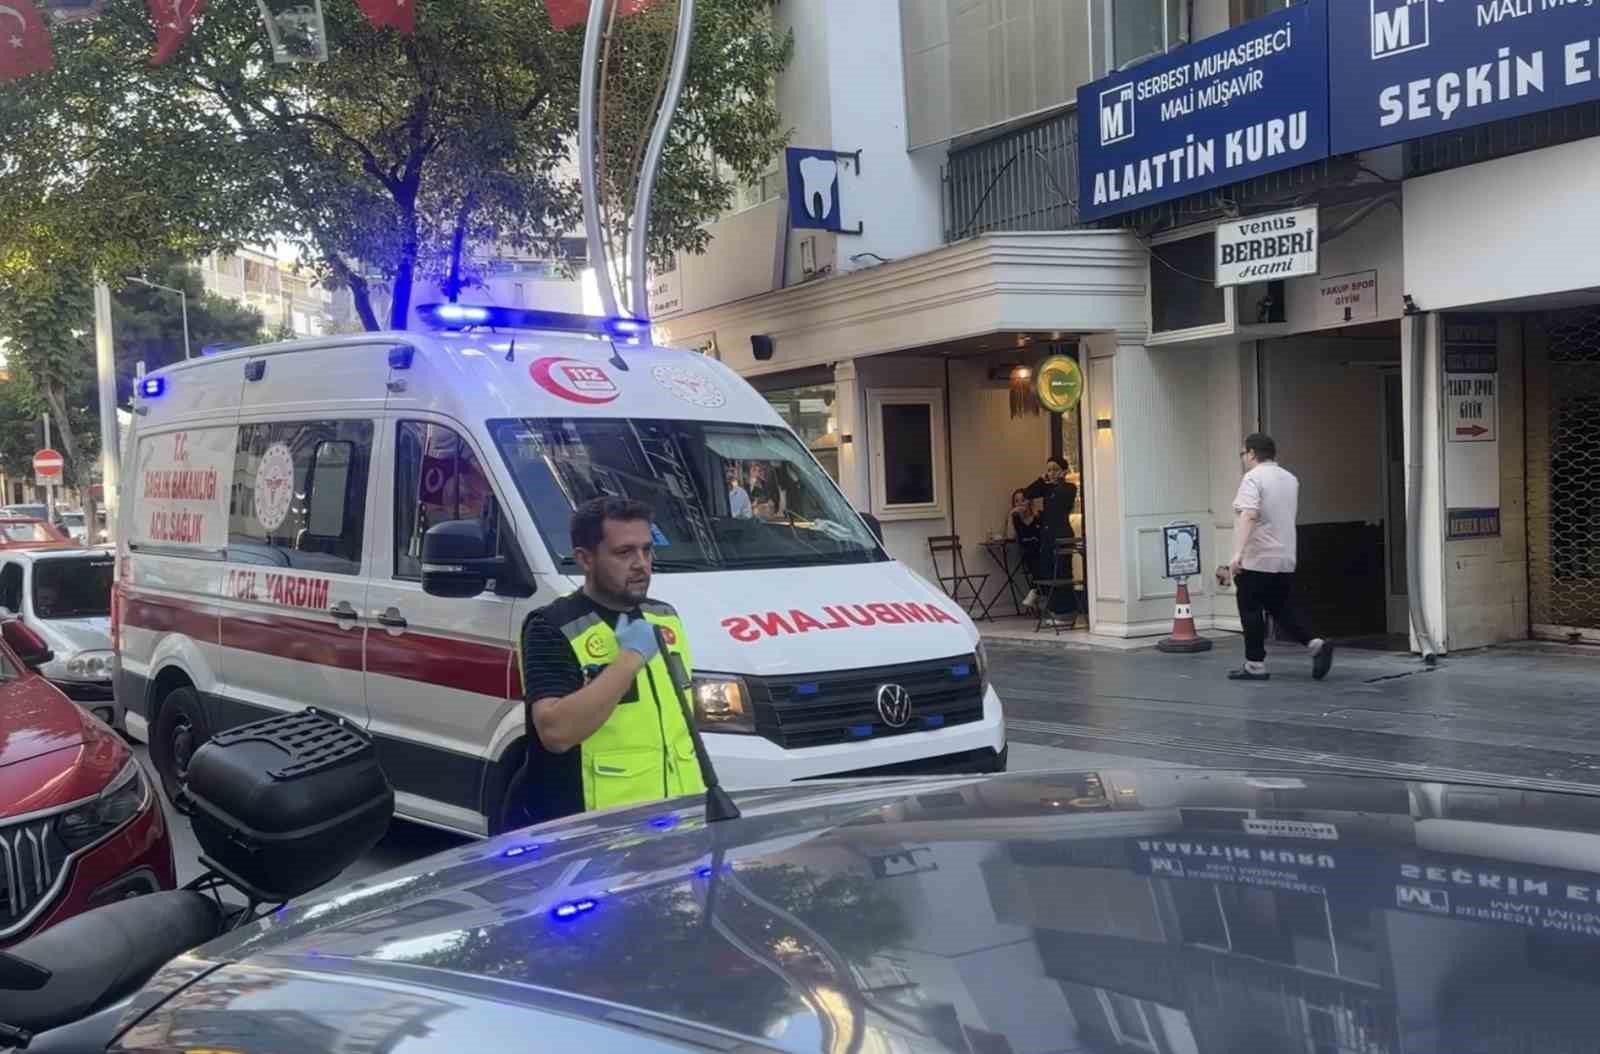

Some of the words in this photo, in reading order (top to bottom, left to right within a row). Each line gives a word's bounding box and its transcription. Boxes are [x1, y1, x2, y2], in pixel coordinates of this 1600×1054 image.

[1137, 65, 1190, 100] SERBEST
[1194, 22, 1291, 80] MUHASEBECİ
[1161, 88, 1194, 121] MALİ
[1198, 67, 1264, 108] MÜŞAVİR
[1379, 47, 1544, 127] SEÇKİN
[1564, 37, 1600, 86] E
[1093, 134, 1215, 205] ALAATTİN
[1225, 111, 1307, 168] KURU
[1220, 228, 1314, 265] BERBERİ
[265, 573, 329, 609] YARDIM
